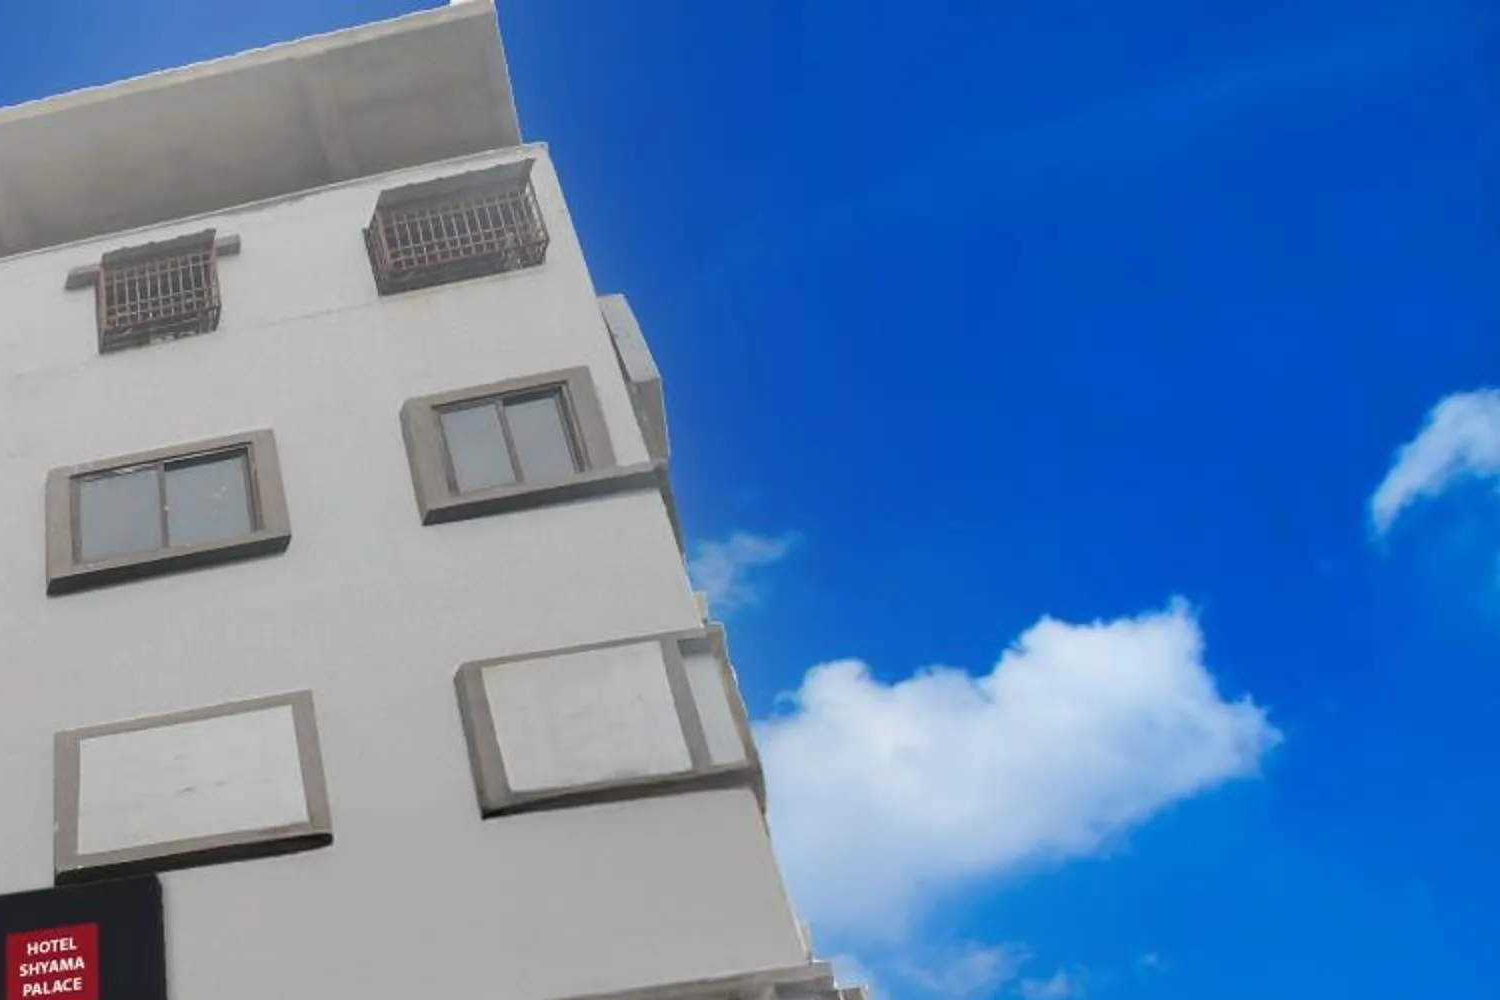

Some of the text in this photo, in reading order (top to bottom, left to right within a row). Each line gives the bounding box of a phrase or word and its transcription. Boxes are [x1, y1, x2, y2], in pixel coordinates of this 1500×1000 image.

[26, 937, 77, 955] HOTEL
[19, 955, 85, 977] SHYAMA
[22, 977, 83, 997] PALACE
